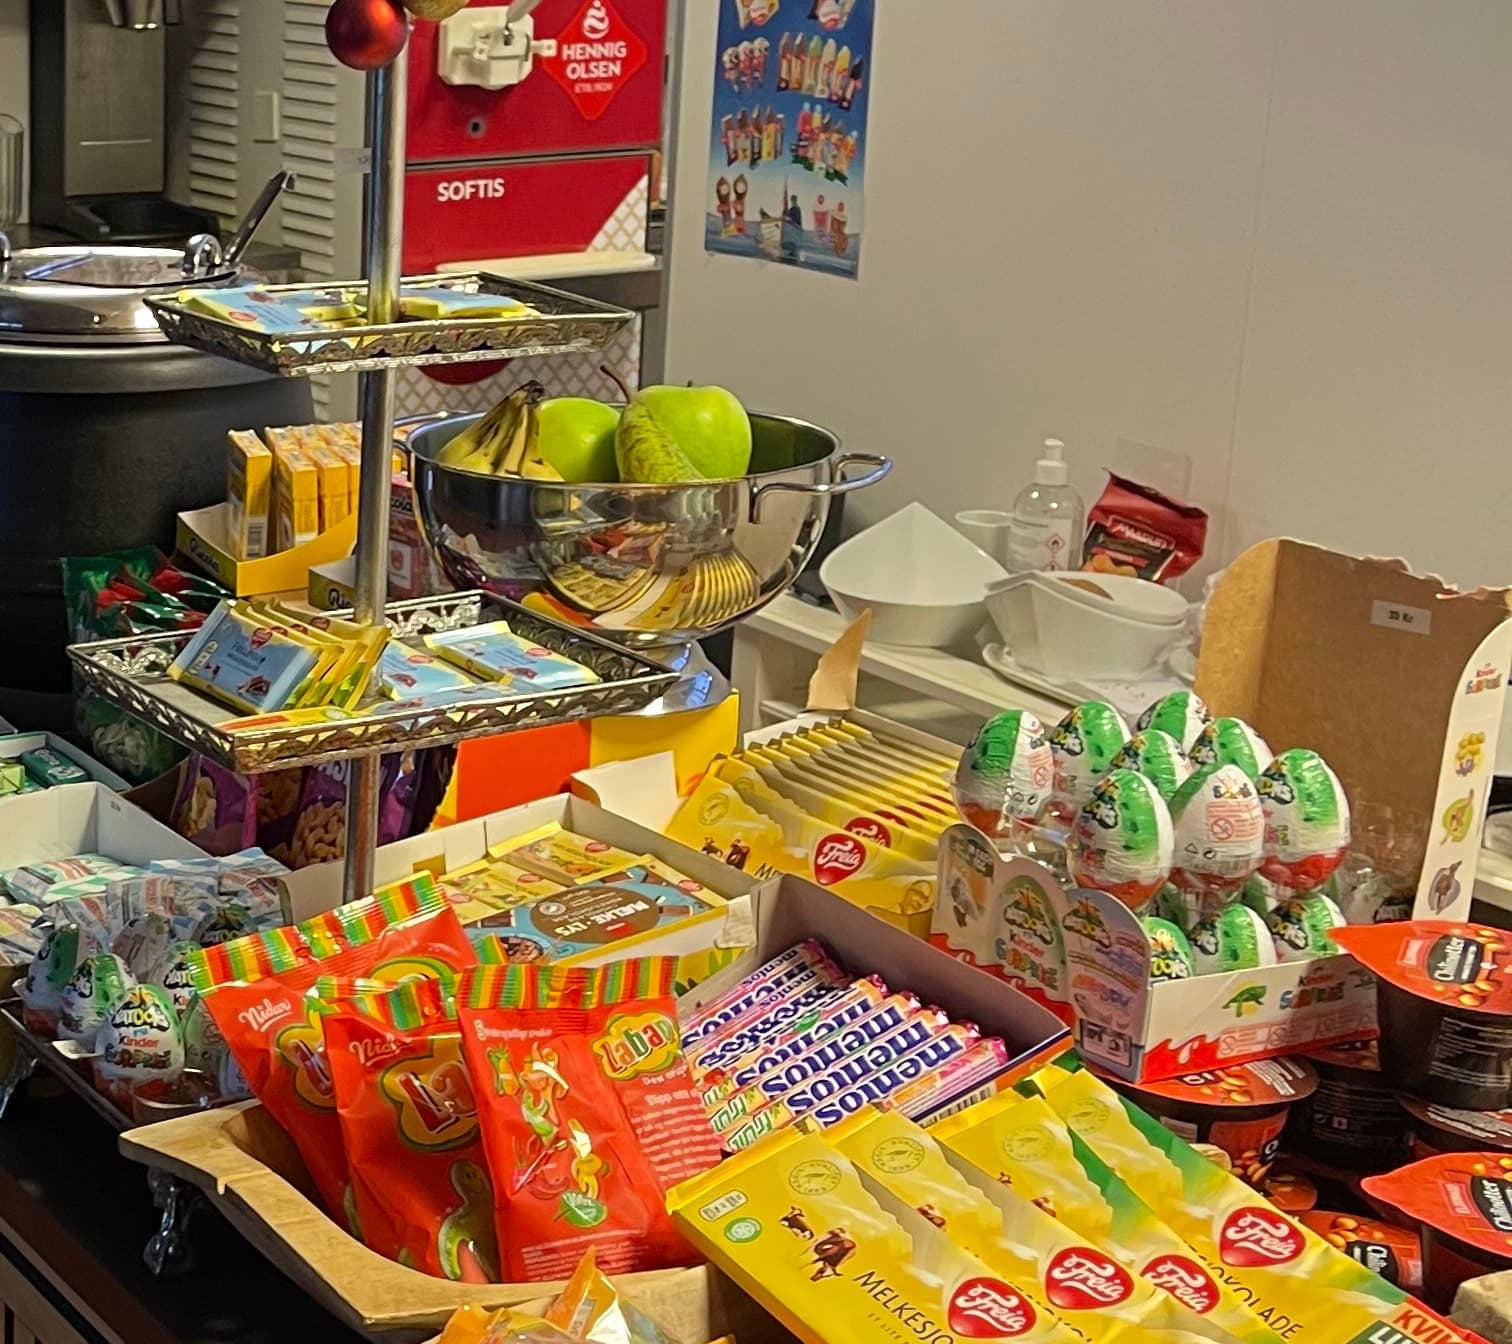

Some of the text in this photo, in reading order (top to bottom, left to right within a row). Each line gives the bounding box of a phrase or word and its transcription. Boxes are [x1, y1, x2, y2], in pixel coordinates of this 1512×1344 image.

[562, 41, 627, 61] HENNIG
[565, 60, 621, 80] OLSEN
[437, 178, 505, 202] SOFTIS
[817, 839, 862, 871] Freia
[238, 998, 292, 1033] Nidar
[119, 1036, 159, 1048] Kinder
[599, 1018, 676, 1075] Laban
[762, 1005, 907, 1098] mentos
[788, 1020, 933, 1115] mentos
[815, 1032, 964, 1129] mentos
[1226, 1213, 1297, 1259] Freia
[1051, 1254, 1125, 1303] Freia
[1143, 1260, 1211, 1312] Freia
[955, 1283, 1028, 1333] Freia
